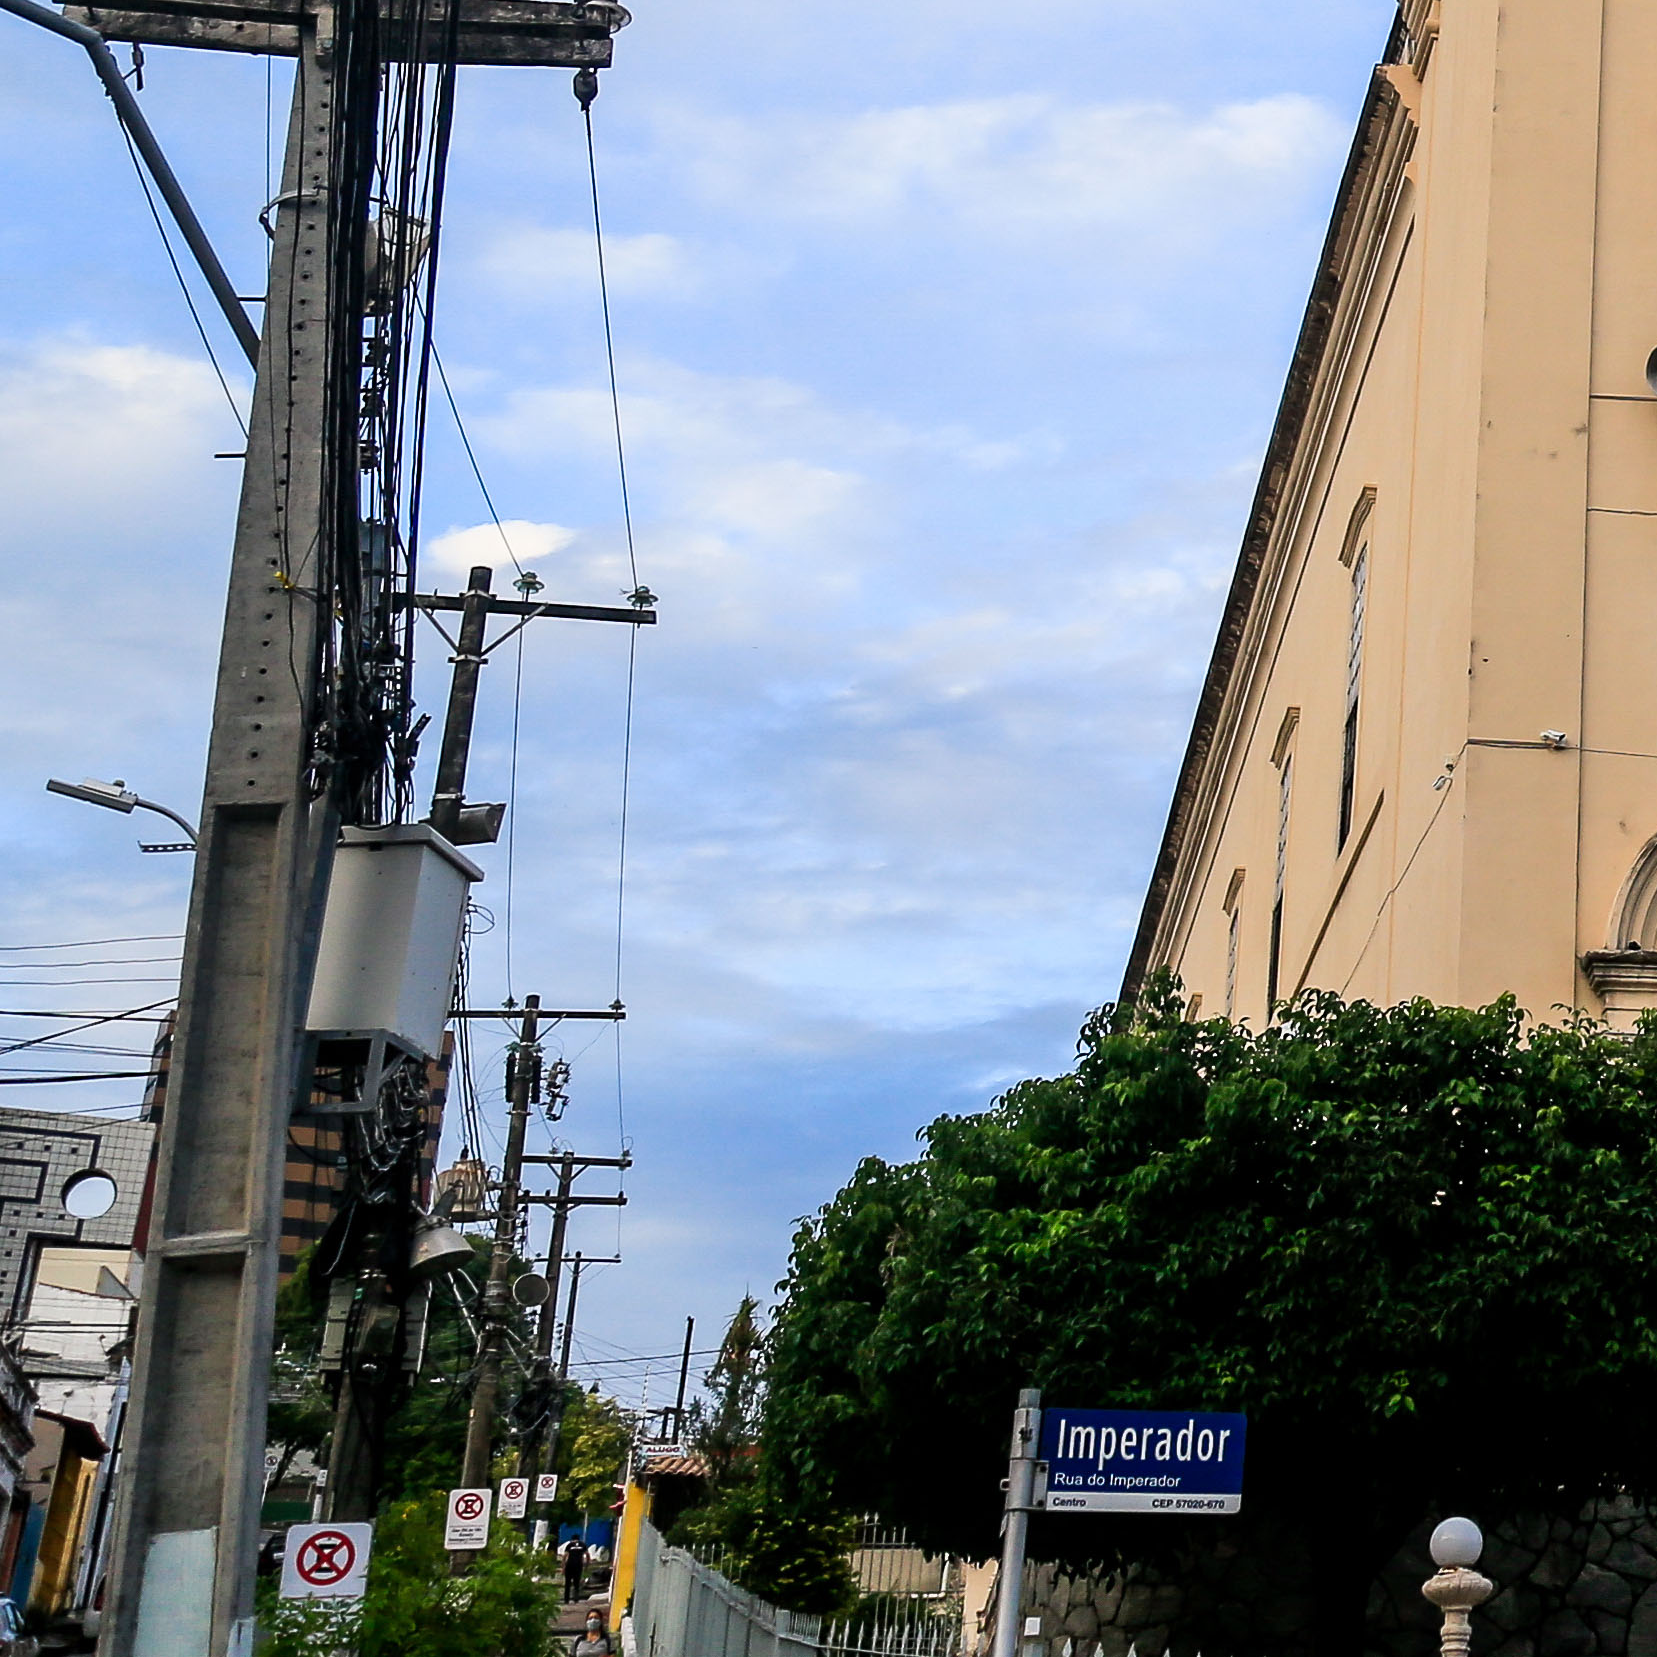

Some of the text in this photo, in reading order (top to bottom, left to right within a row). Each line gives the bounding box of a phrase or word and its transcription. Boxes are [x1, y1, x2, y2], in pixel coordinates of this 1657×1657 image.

[1056, 1418, 1231, 1471] Imperador
[1054, 1472, 1181, 1489] Rua do Imperador
[1052, 1497, 1225, 1510] Centro CEP 57020-670
